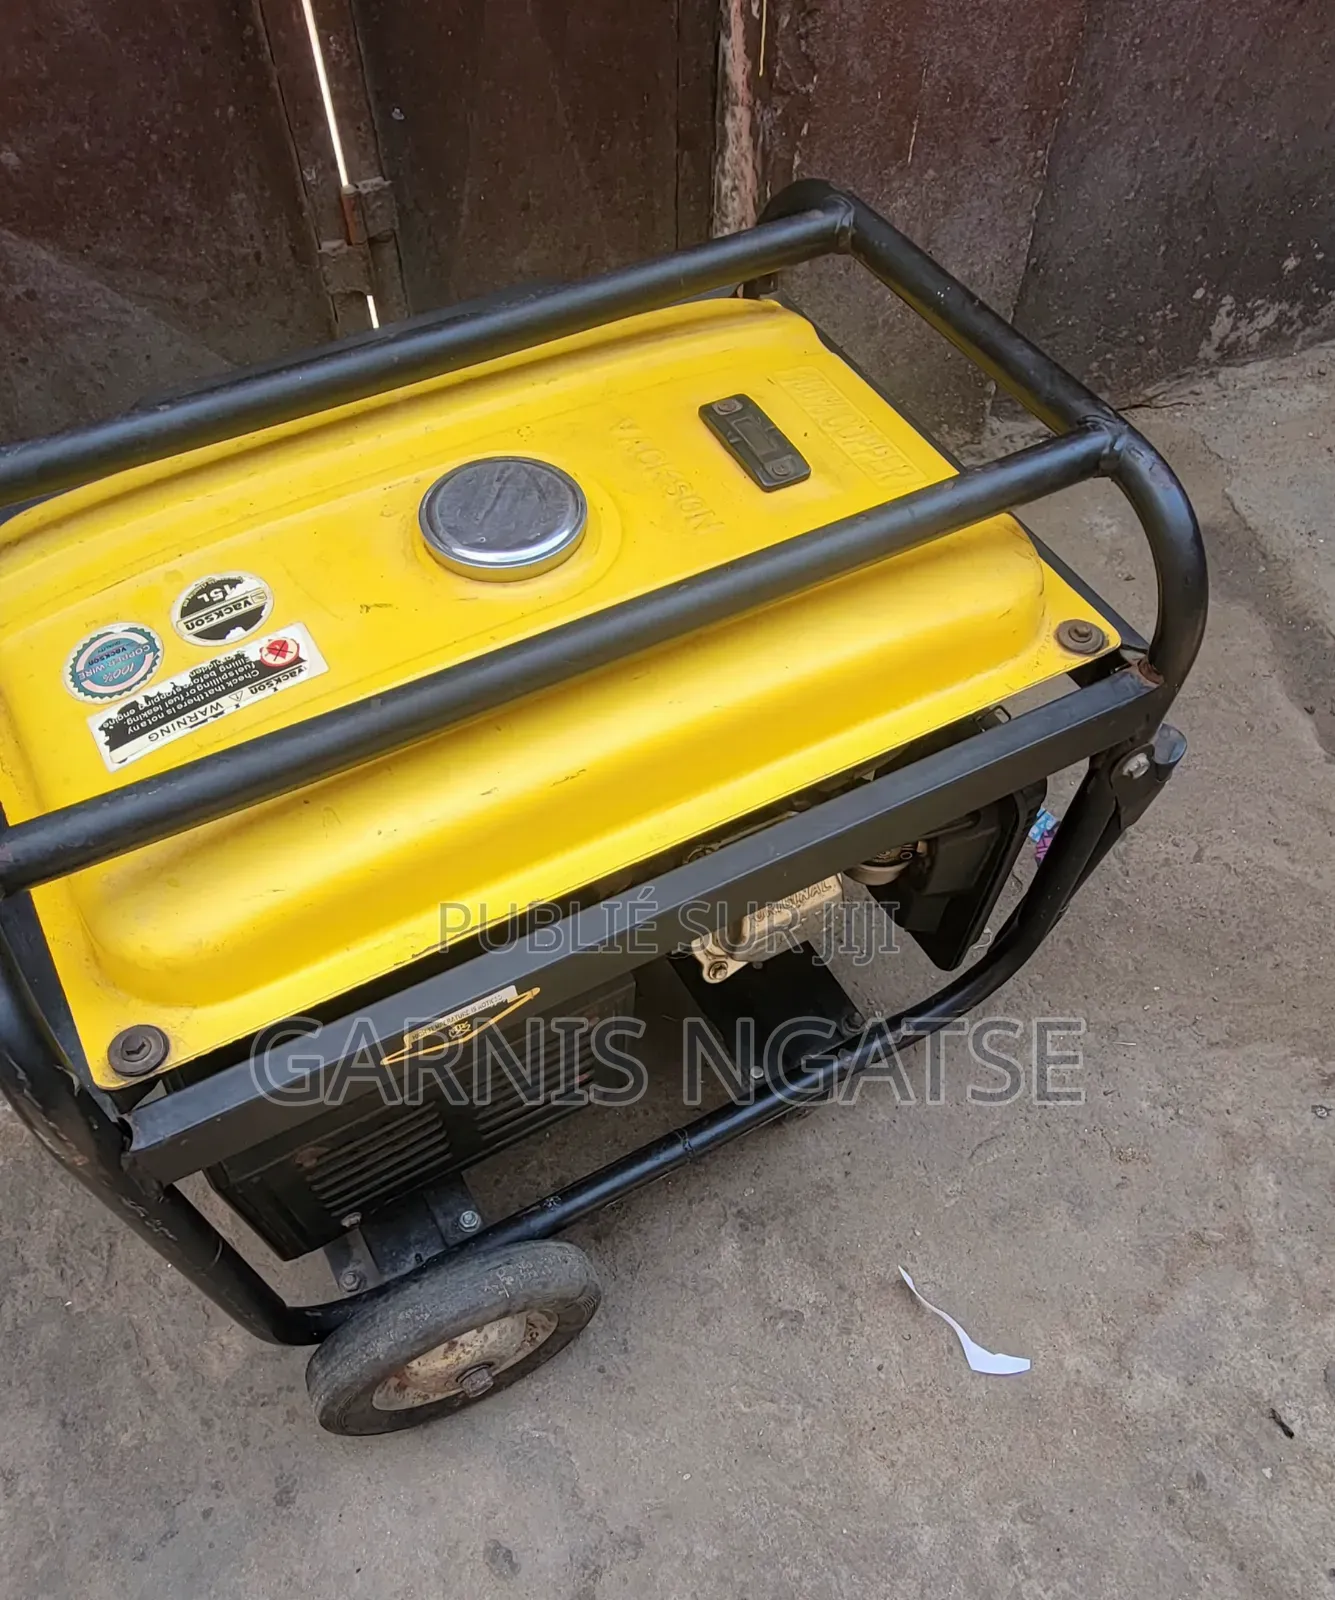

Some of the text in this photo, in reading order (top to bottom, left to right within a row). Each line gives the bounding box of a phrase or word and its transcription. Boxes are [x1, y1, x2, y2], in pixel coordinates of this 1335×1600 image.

[824, 411, 917, 480] COPPER
[78, 645, 150, 680] COPPER WIRE
[103, 662, 134, 683] 100%
[226, 670, 259, 689] Check
[165, 694, 184, 708] fuel
[166, 707, 175, 716] is
[102, 709, 135, 729] engine
[123, 705, 162, 726] leaking.
[147, 702, 224, 742] WARNING
[754, 881, 832, 922] ORIGINAL
